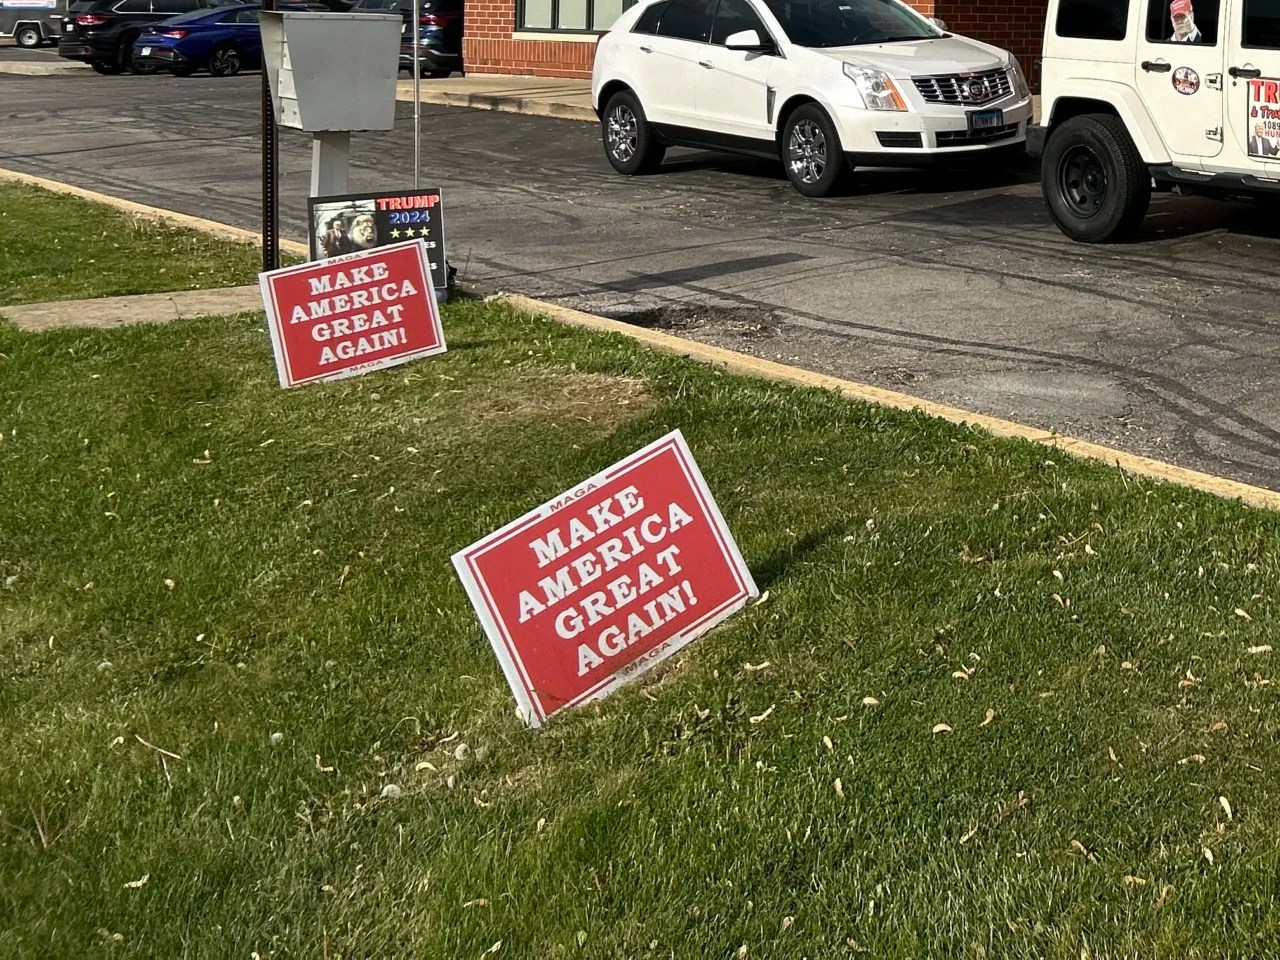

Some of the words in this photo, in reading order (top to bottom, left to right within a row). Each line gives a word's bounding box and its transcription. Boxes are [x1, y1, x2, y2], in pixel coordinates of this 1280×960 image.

[377, 194, 440, 211] TRUMP
[389, 210, 430, 224] 2024
[328, 253, 363, 265] MAGA
[308, 262, 390, 296] MAKE
[290, 279, 418, 325] AMERICA
[311, 304, 405, 342] GREAT
[319, 327, 408, 366] AGAIN!
[349, 360, 385, 373] MAGA
[549, 481, 599, 512] MAGA
[529, 484, 645, 569] MAKE
[517, 501, 694, 624] AMERICA
[554, 544, 684, 641] GREAT
[576, 579, 699, 677] AGAIN!
[623, 640, 671, 677] MAGA
